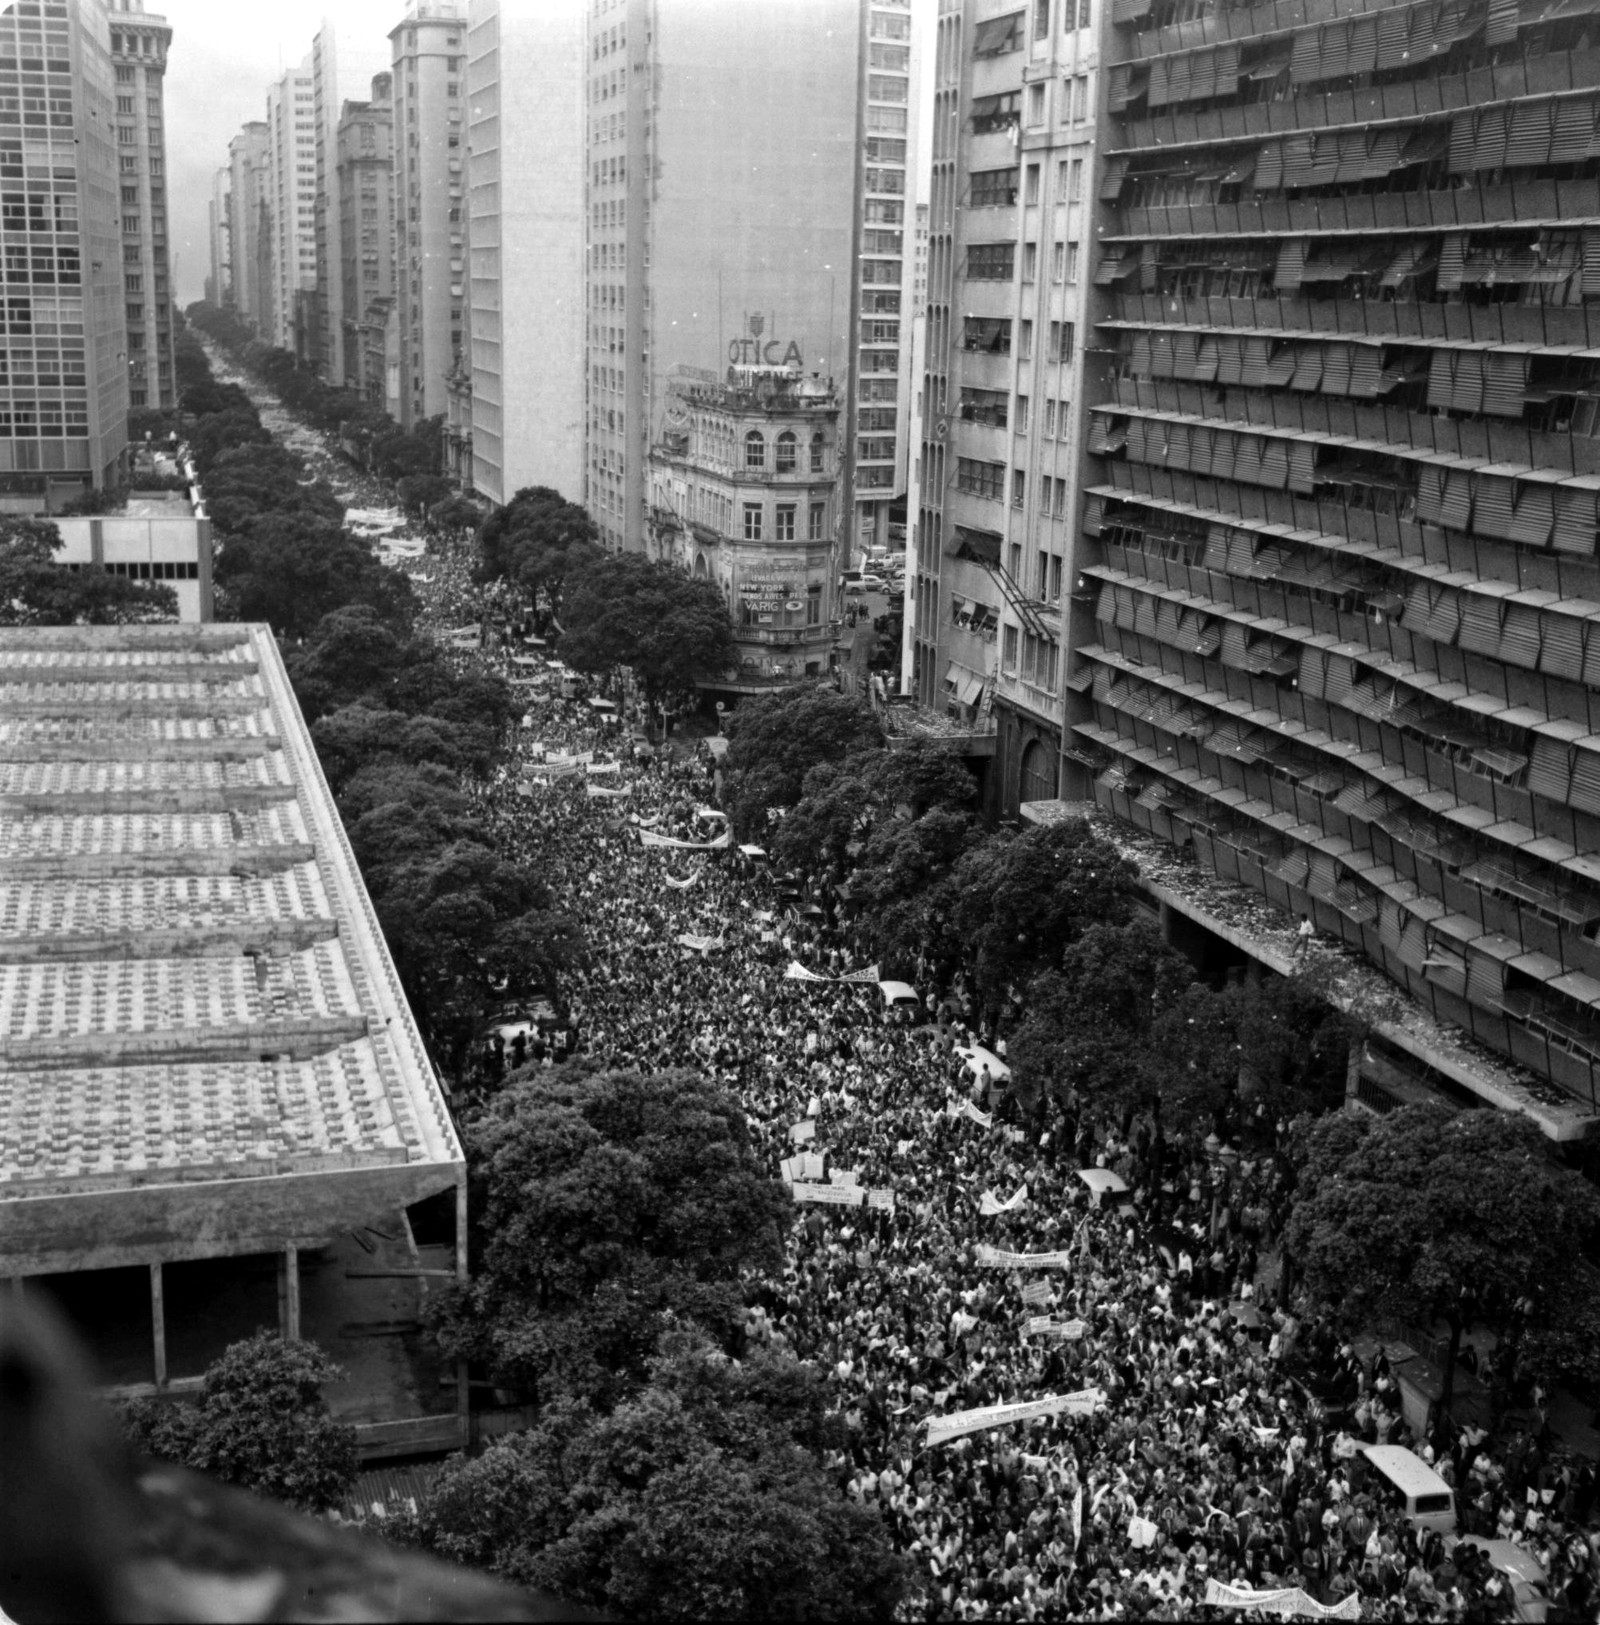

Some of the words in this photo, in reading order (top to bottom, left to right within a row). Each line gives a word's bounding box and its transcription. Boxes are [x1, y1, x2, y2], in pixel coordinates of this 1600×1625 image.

[760, 584, 784, 592] YORK
[764, 592, 784, 600] AIRES
[744, 600, 779, 611] VARIG
